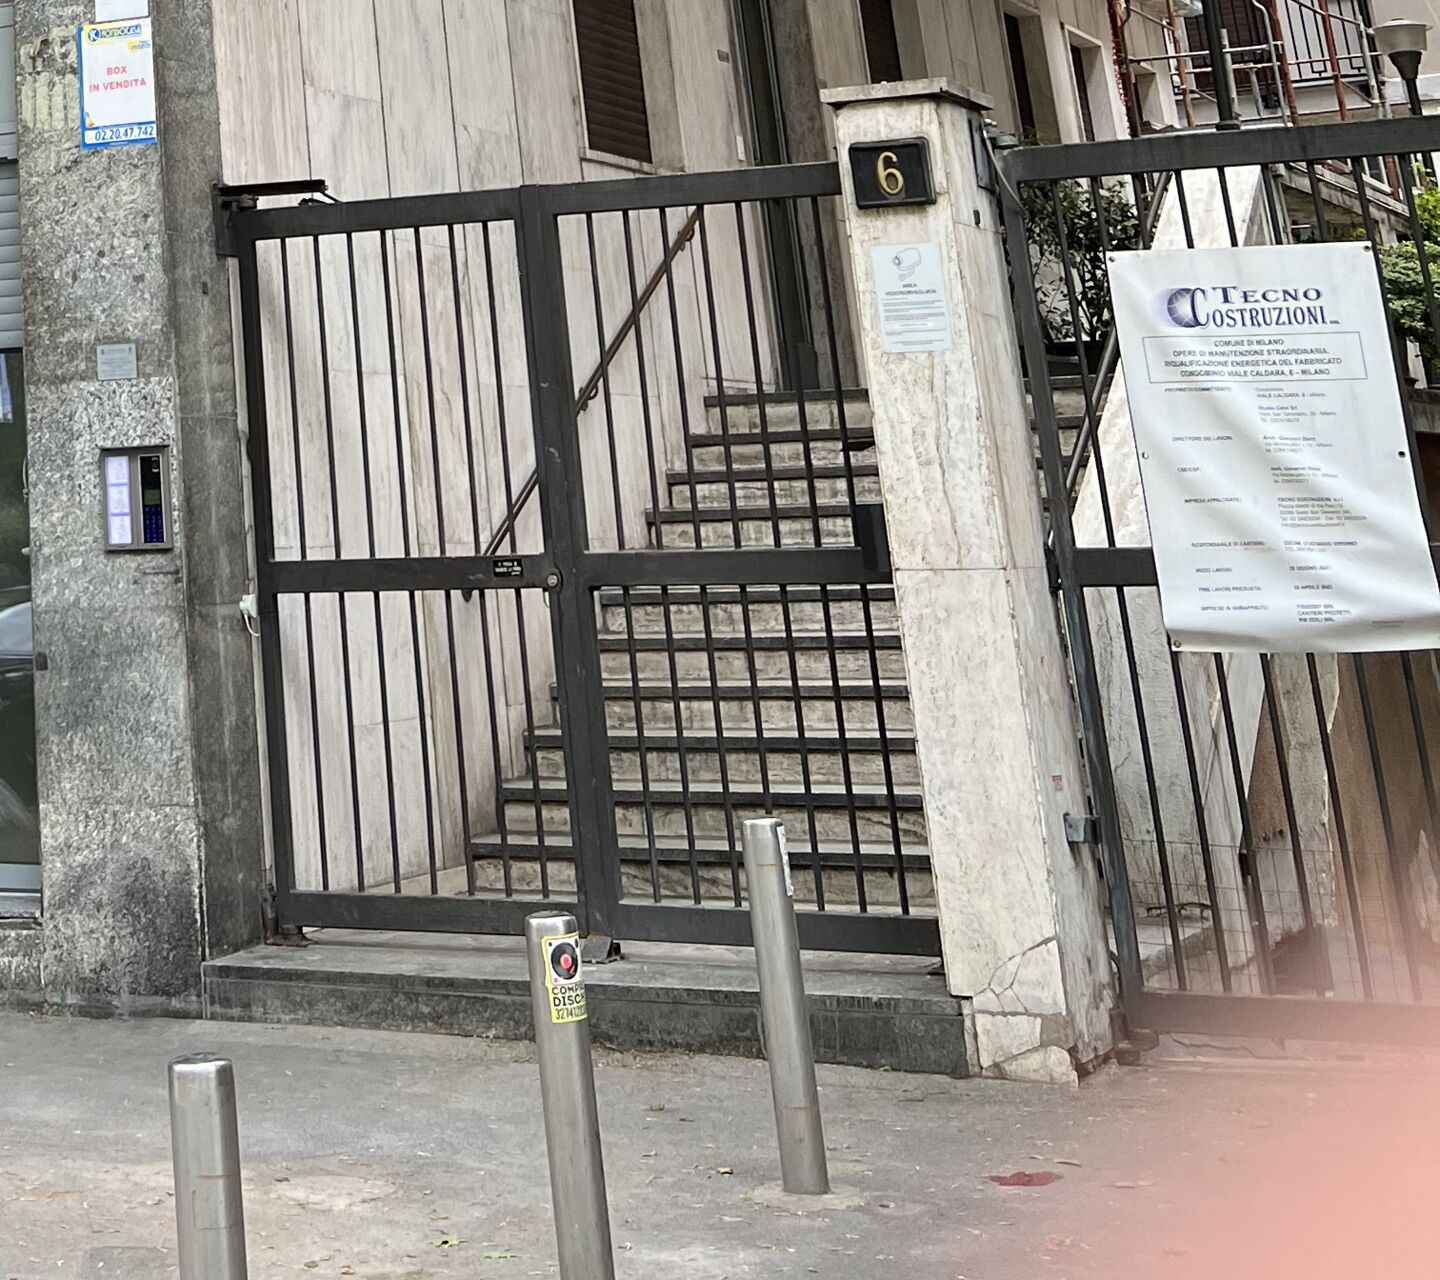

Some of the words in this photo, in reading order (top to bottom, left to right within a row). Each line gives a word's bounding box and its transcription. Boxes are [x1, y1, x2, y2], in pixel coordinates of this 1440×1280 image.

[106, 65, 128, 76] BOX
[89, 84, 100, 92] IN
[102, 78, 147, 91] VENDITA
[876, 151, 905, 196] 6
[1210, 285, 1322, 305] TECNO
[1190, 287, 1328, 329] COSTRUZIONI
[1213, 339, 1245, 347] COMUNE
[1208, 348, 1265, 357] MANUTENZIONE
[1164, 360, 1229, 368] RIQUALIFICAZIONE
[1230, 359, 1278, 367] ENERGETICA
[1294, 357, 1343, 366] FABBRICATO
